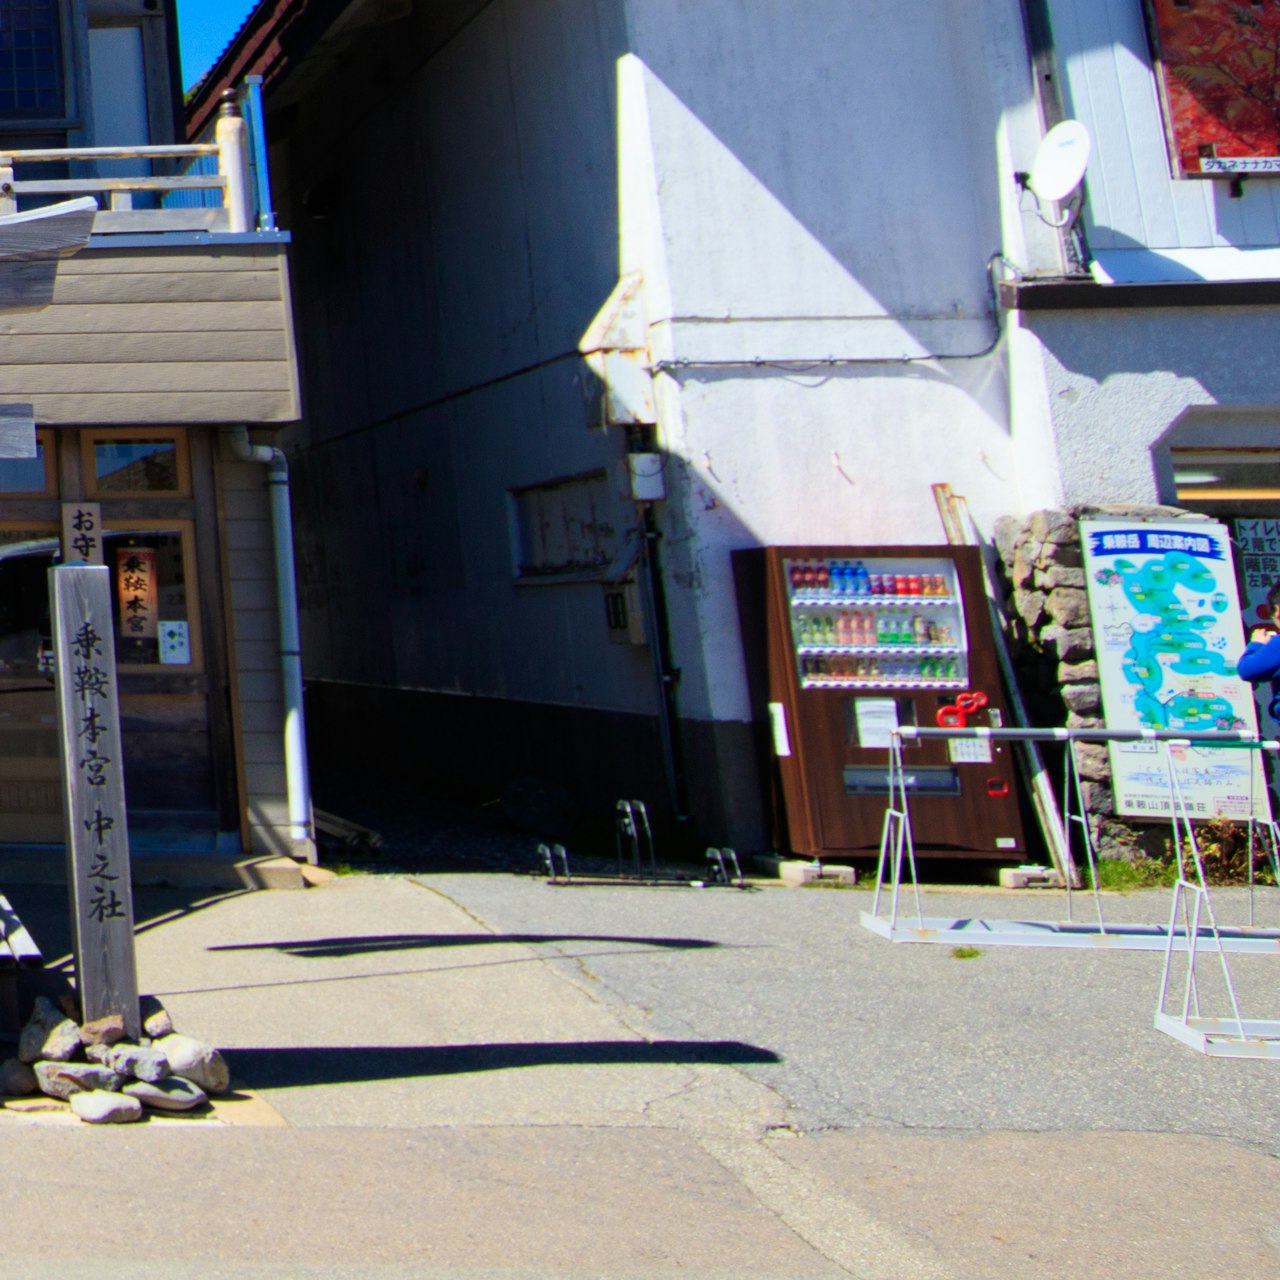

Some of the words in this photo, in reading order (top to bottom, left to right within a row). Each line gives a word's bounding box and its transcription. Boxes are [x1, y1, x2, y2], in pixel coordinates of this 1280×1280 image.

[71, 509, 97, 562] お守
[1240, 537, 1280, 552] 2階で
[122, 554, 149, 633] 乗鞍本宮
[70, 622, 110, 787] 乗鞍本宮
[84, 809, 127, 923] 中之社
